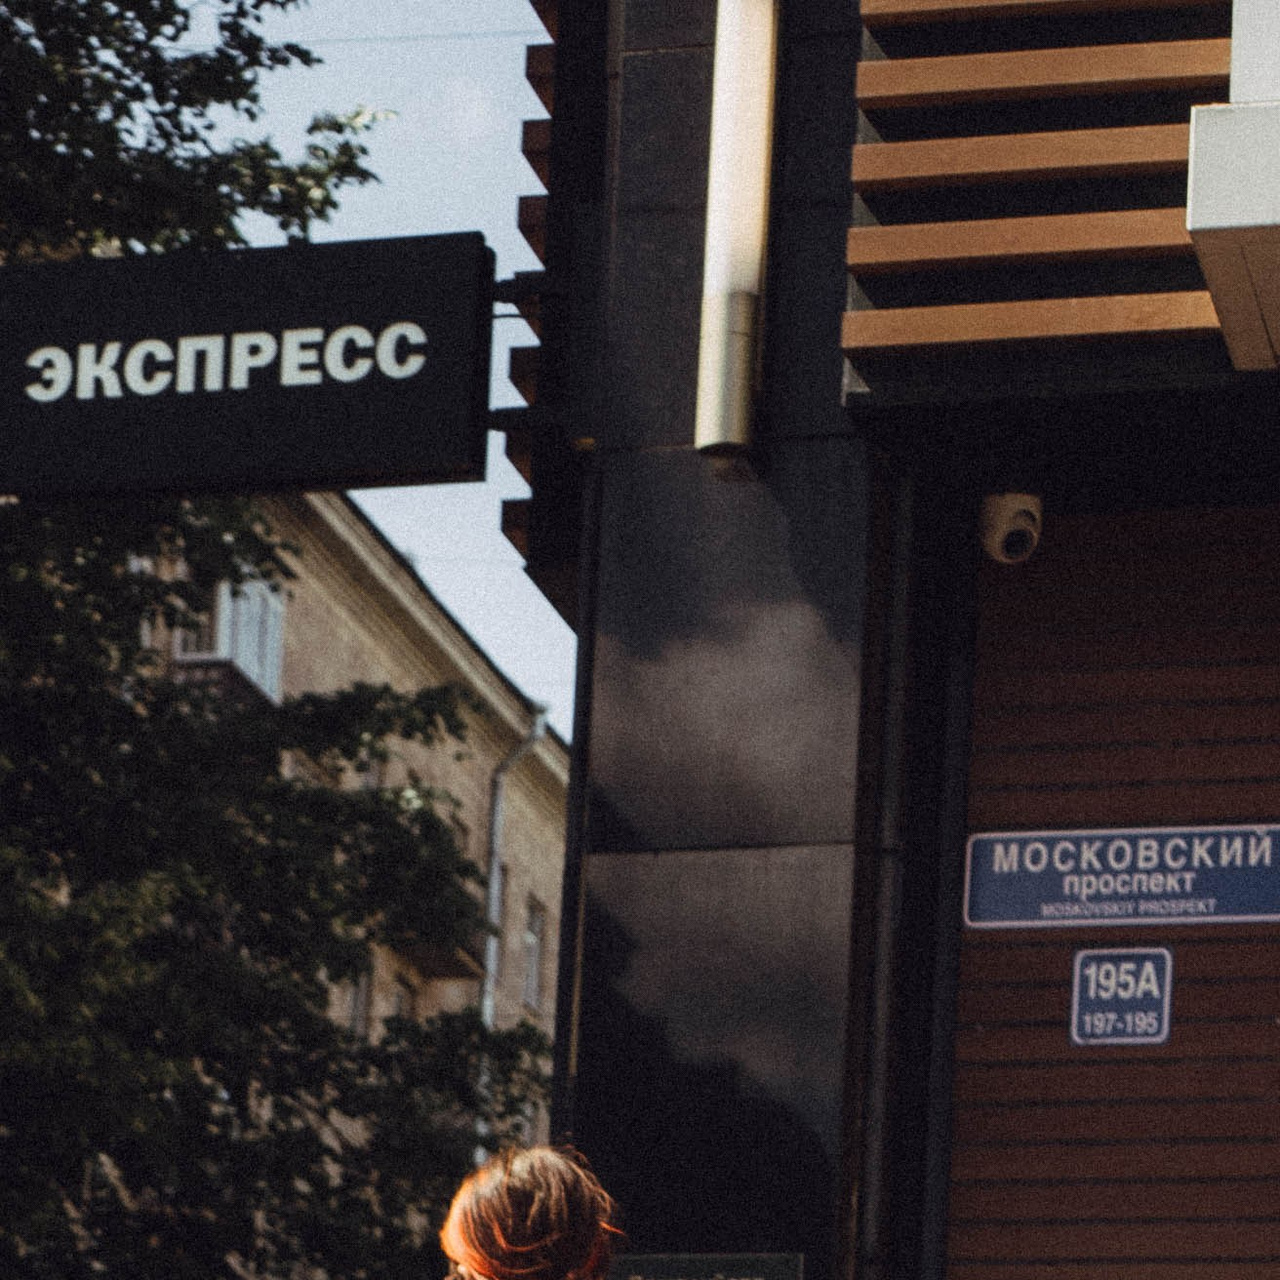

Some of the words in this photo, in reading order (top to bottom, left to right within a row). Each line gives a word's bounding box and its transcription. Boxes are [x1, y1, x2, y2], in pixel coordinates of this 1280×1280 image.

[25, 322, 428, 402] ЭКСПРЕСС
[991, 830, 1272, 873] МОСКОВСКИЙ
[1062, 871, 1197, 901] проспект
[1084, 961, 1161, 1001] 195А
[1083, 1011, 1160, 1036] 197-195
